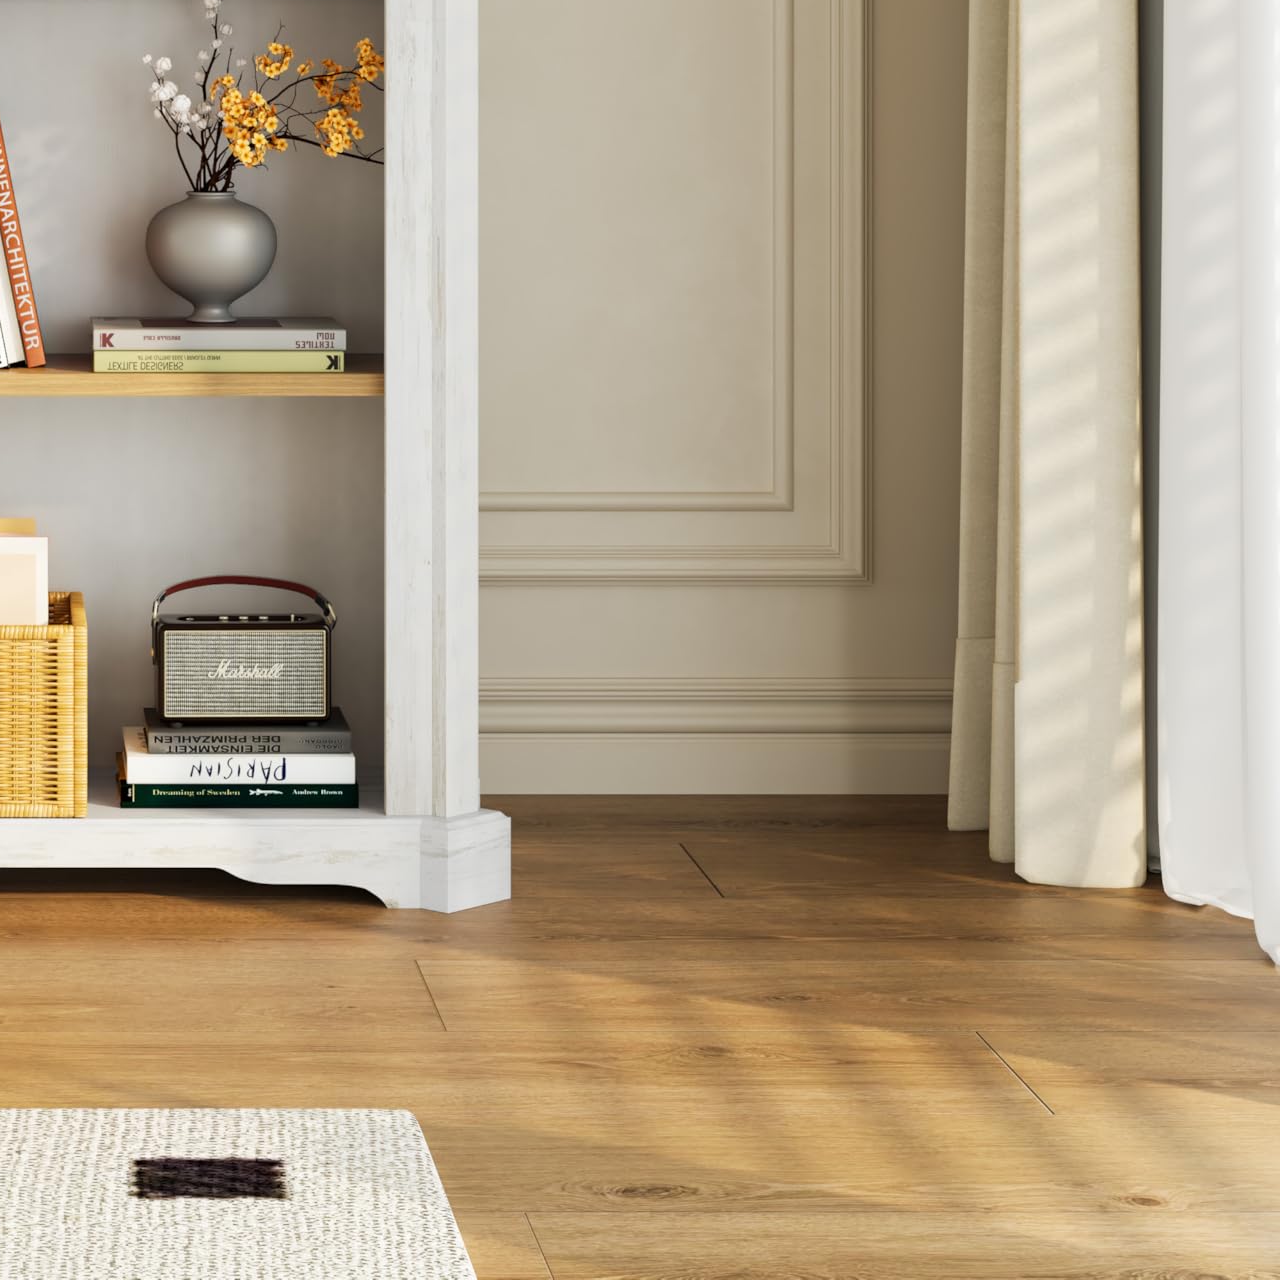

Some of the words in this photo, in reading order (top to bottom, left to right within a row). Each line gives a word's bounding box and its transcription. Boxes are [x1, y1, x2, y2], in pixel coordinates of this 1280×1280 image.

[208, 658, 284, 679] Marshall
[154, 735, 247, 743] PRIMZAHLEN
[252, 735, 281, 743] DER
[167, 744, 253, 753] EINSAMKEIT
[258, 744, 281, 753] DIE
[190, 756, 287, 784] PARISIAN
[152, 789, 194, 797] Dreaming
